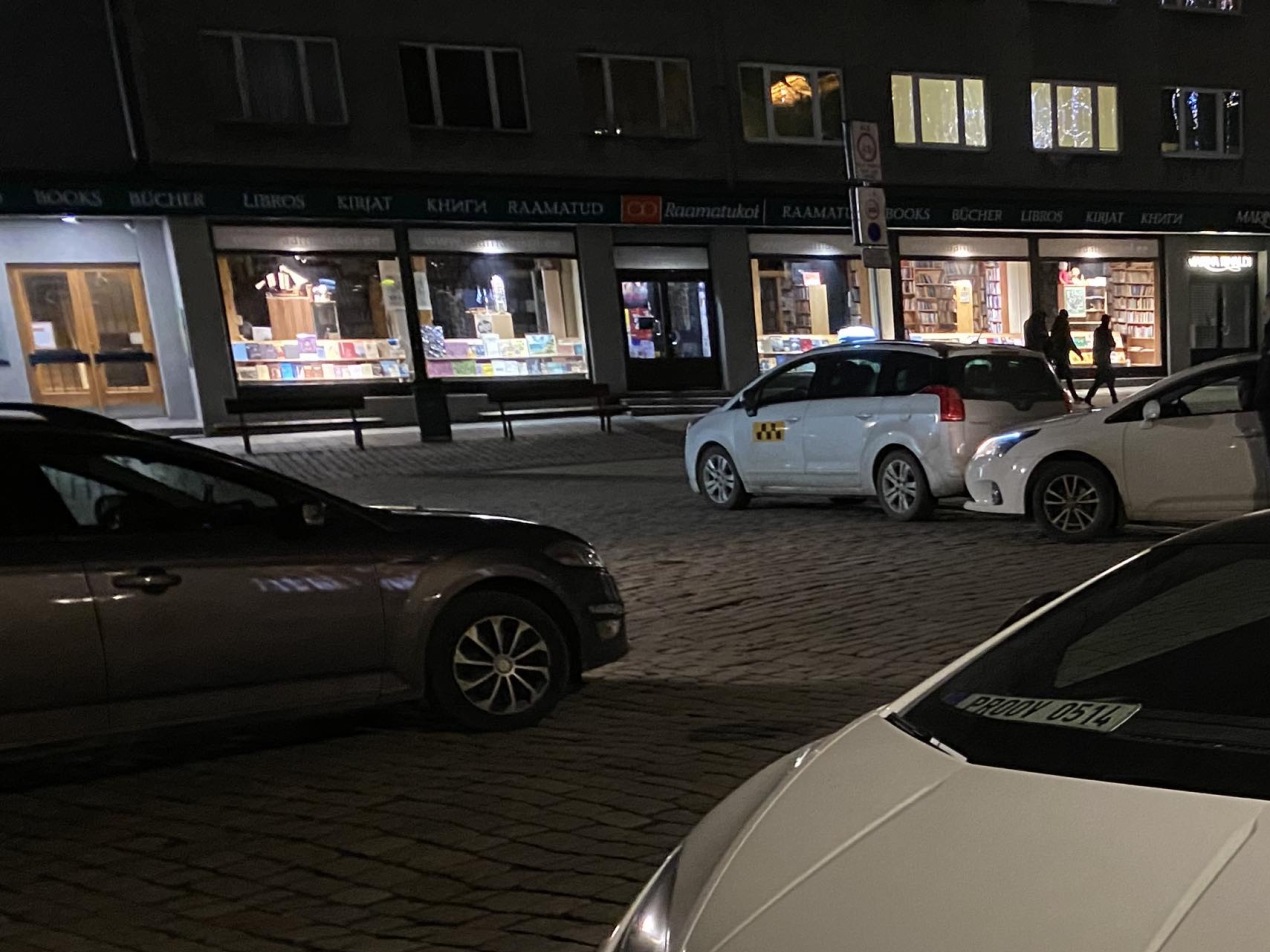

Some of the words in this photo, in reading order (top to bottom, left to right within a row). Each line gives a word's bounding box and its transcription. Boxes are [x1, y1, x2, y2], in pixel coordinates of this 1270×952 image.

[32, 188, 103, 207] BOOKS
[242, 193, 306, 209] LIBROS
[507, 200, 604, 216] RAAMATUD
[664, 201, 761, 219] Raamatukoi
[886, 207, 931, 221] BOOKS
[952, 206, 1003, 222] BÜCHER
[1021, 209, 1064, 224] LIBROS
[1046, 702, 1121, 727] 0514
